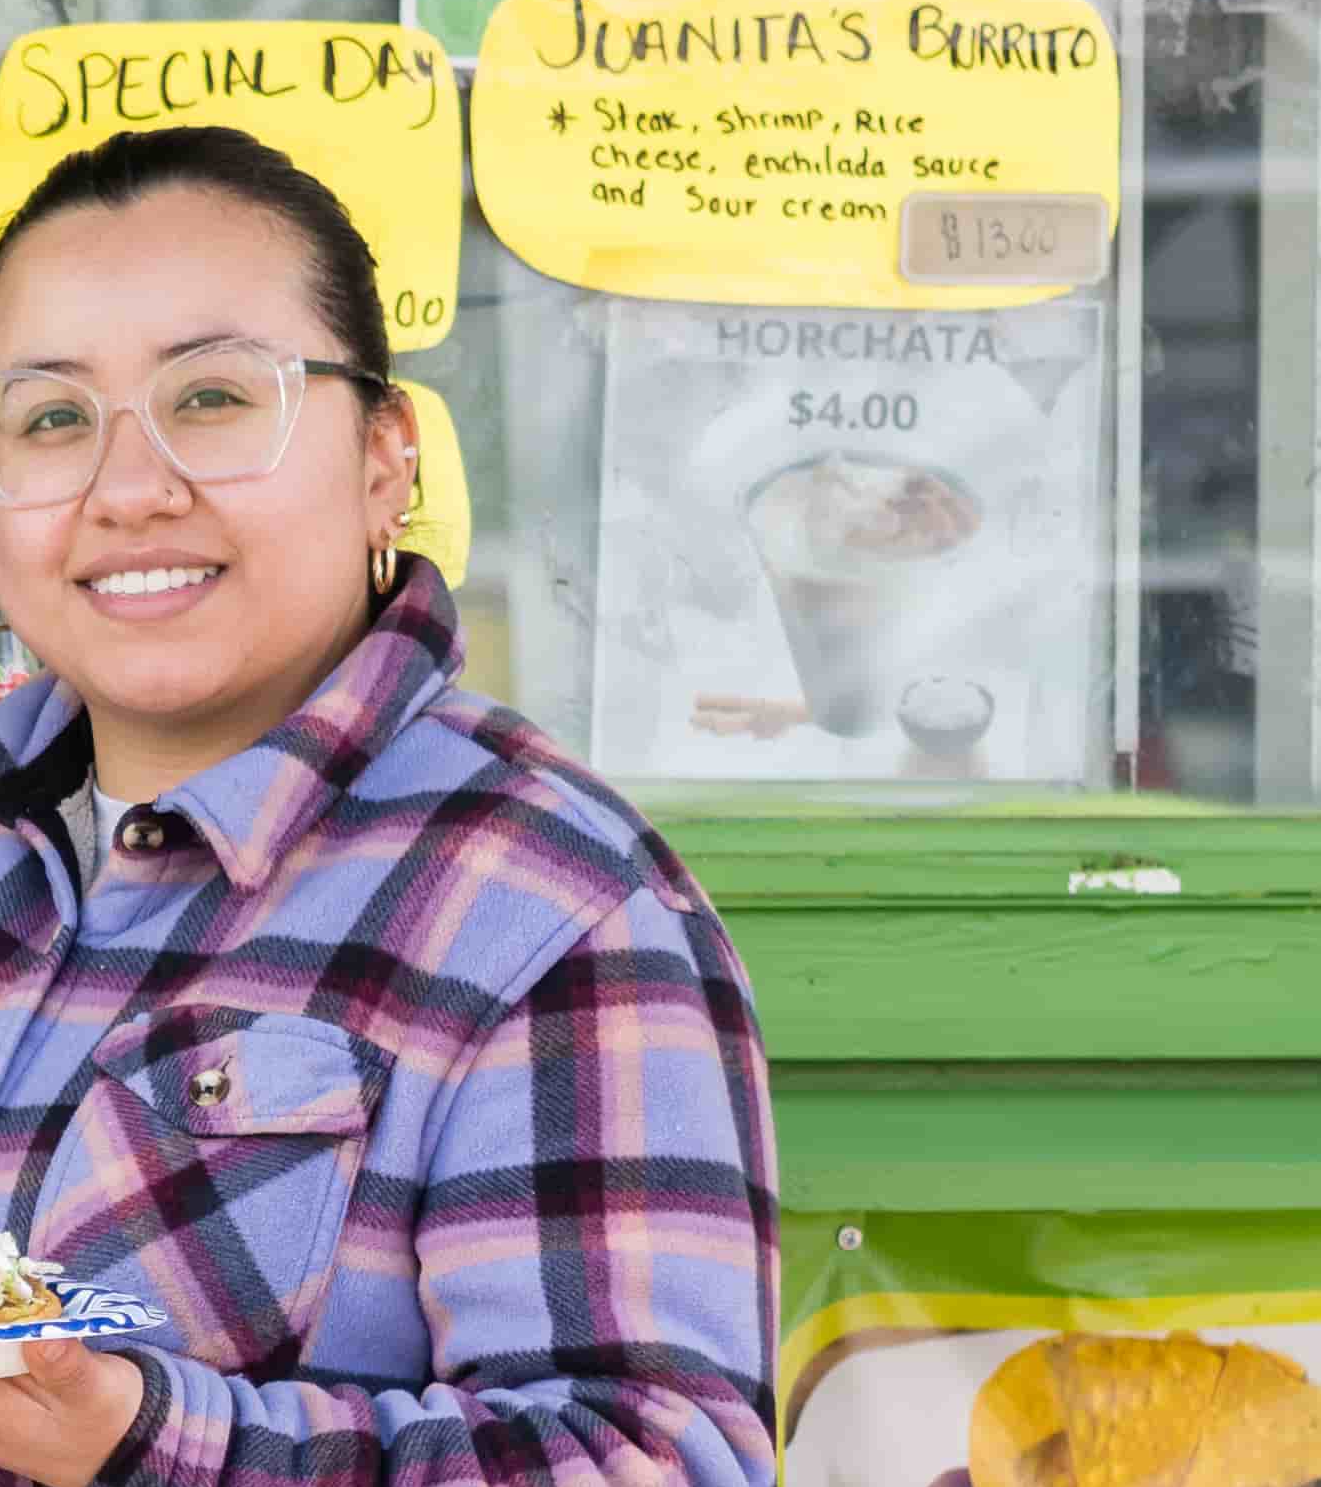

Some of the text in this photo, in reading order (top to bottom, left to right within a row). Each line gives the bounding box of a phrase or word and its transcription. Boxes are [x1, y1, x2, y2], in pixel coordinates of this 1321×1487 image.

[907, 3, 1098, 75] BURRITO
[18, 40, 297, 139] SPECIAL
[744, 145, 887, 179] enchilada
[591, 181, 646, 208] and
[782, 199, 888, 222] cream
[714, 318, 1000, 365] HORCHATA
[786, 389, 921, 434] $4.00
